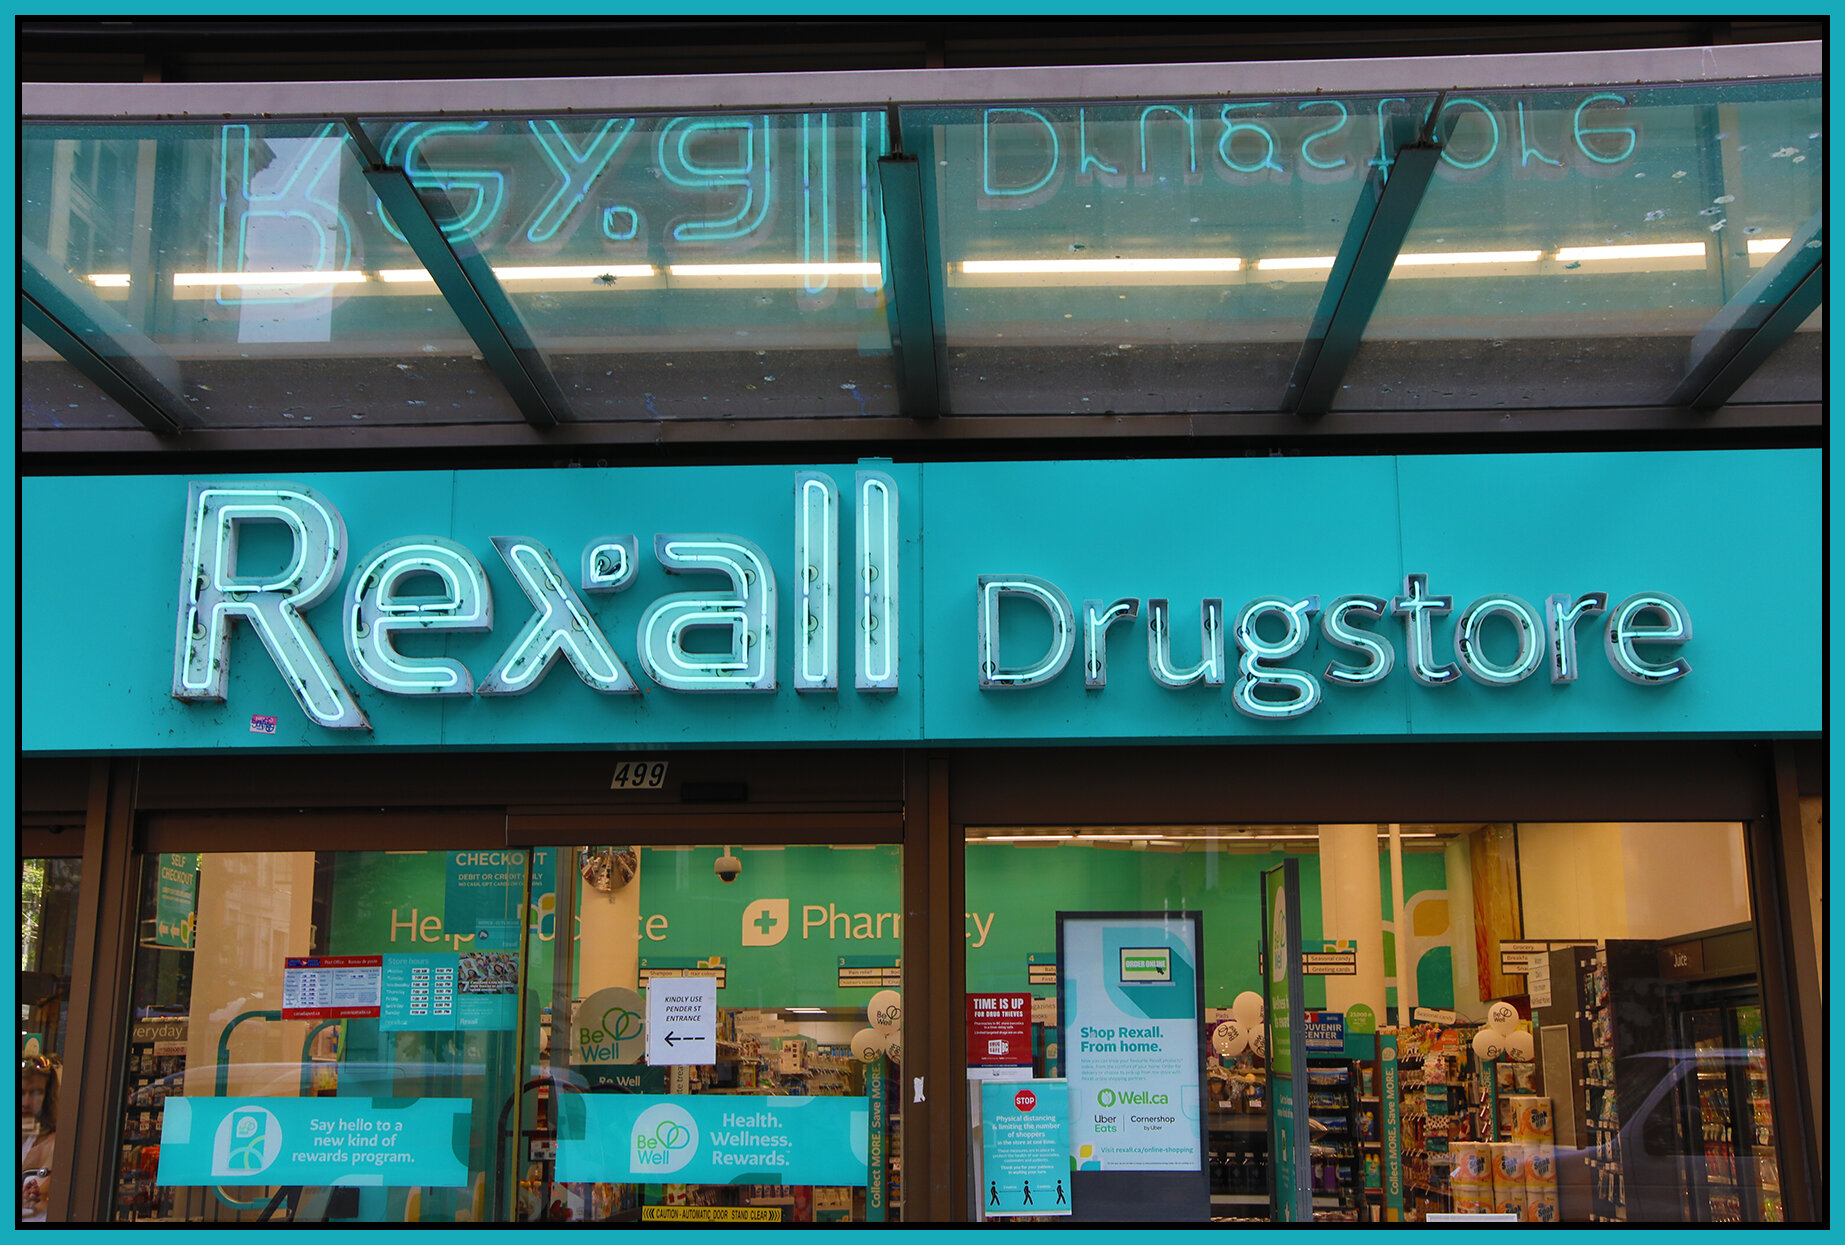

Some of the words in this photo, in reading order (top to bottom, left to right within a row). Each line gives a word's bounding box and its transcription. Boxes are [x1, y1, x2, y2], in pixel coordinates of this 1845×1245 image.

[172, 470, 898, 733] Rexall
[977, 573, 1692, 720] Drugstore
[614, 762, 665, 788] 499
[171, 853, 186, 867] SELF
[456, 852, 548, 866] CHECKOT
[161, 866, 194, 885] CHECKOUT
[641, 958, 648, 967] 2
[840, 958, 846, 966] 3
[1028, 954, 1035, 962] 4
[1126, 960, 1145, 968] ORDER
[1145, 960, 1166, 968] ONLINE
[1673, 952, 1688, 967] Juice
[973, 998, 997, 1010] TIME
[999, 998, 1009, 1010] IS
[1011, 998, 1024, 1010] UP
[877, 1010, 887, 1020] Be
[580, 1028, 605, 1045] Be
[1080, 1026, 1115, 1041] Shop
[1118, 1026, 1164, 1038] Rexall.
[581, 1042, 620, 1063] Well
[1081, 1041, 1117, 1053] From
[1120, 1040, 1162, 1053] home.
[616, 1074, 641, 1087] Well
[872, 1063, 881, 1099] MORE.
[1385, 1067, 1395, 1099] MORE.
[1016, 1097, 1035, 1105] STOP
[1118, 1091, 1169, 1105] Well.ca
[722, 1112, 783, 1128] Health.
[872, 1102, 881, 1128] Save
[996, 1115, 1022, 1123] Physical
[1094, 1115, 1117, 1123] Uber
[1130, 1115, 1176, 1124] Cornershop
[1387, 1102, 1396, 1125] Save
[310, 1118, 336, 1133] Say
[339, 1118, 373, 1131] hello
[376, 1120, 391, 1131] to
[394, 1121, 403, 1131] a
[998, 1123, 1022, 1131] limiting
[1095, 1124, 1117, 1133] Eats
[314, 1136, 345, 1147] new
[347, 1133, 378, 1147] kind
[381, 1133, 398, 1147] of
[637, 1134, 658, 1149] Be
[710, 1131, 793, 1147] Wellness.
[1016, 1131, 1045, 1139] shoppers
[1389, 1126, 1397, 1159] MORE.
[872, 1130, 881, 1166] MORE.
[1115, 1146, 1194, 1154] rexall.ca/online-shopping
[292, 1149, 349, 1162] rewards
[352, 1150, 415, 1167] program.
[637, 1150, 670, 1165] Well
[712, 1150, 790, 1167] Rewards.
[1390, 1162, 1399, 1195] Collect
[871, 1170, 881, 1208] Collect
[656, 1207, 678, 1218] CAUTION
[683, 1208, 711, 1219] AUTOMATIC
[712, 1208, 728, 1219] DOOR
[731, 1208, 748, 1220] STAND
[751, 1209, 768, 1220] CLEAR
